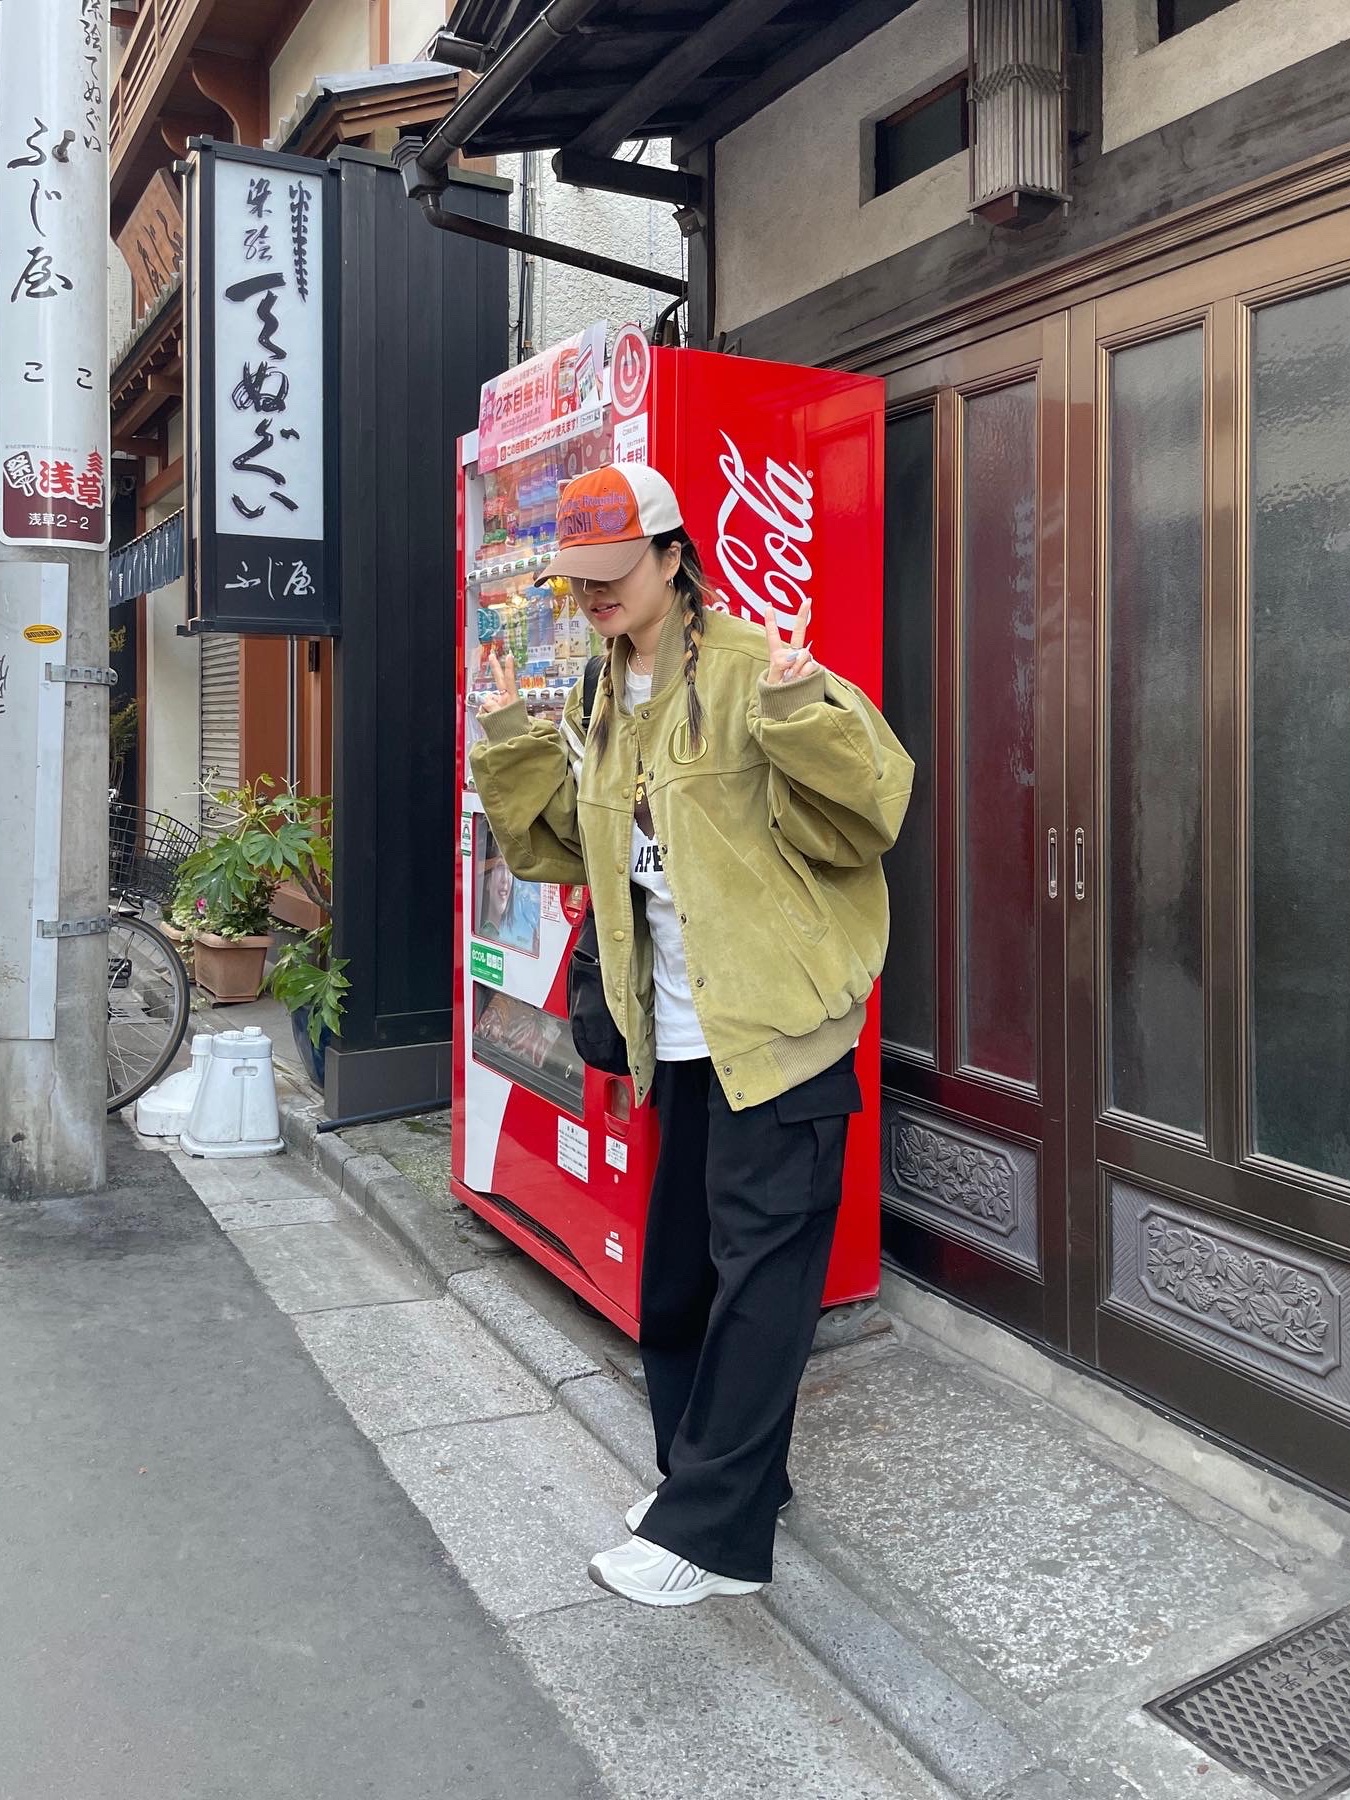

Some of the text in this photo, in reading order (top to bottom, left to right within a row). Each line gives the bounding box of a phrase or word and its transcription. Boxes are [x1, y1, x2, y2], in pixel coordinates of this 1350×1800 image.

[39, 460, 101, 506] 浅草
[225, 556, 316, 600] ふじ屋
[634, 845, 664, 873] APE
